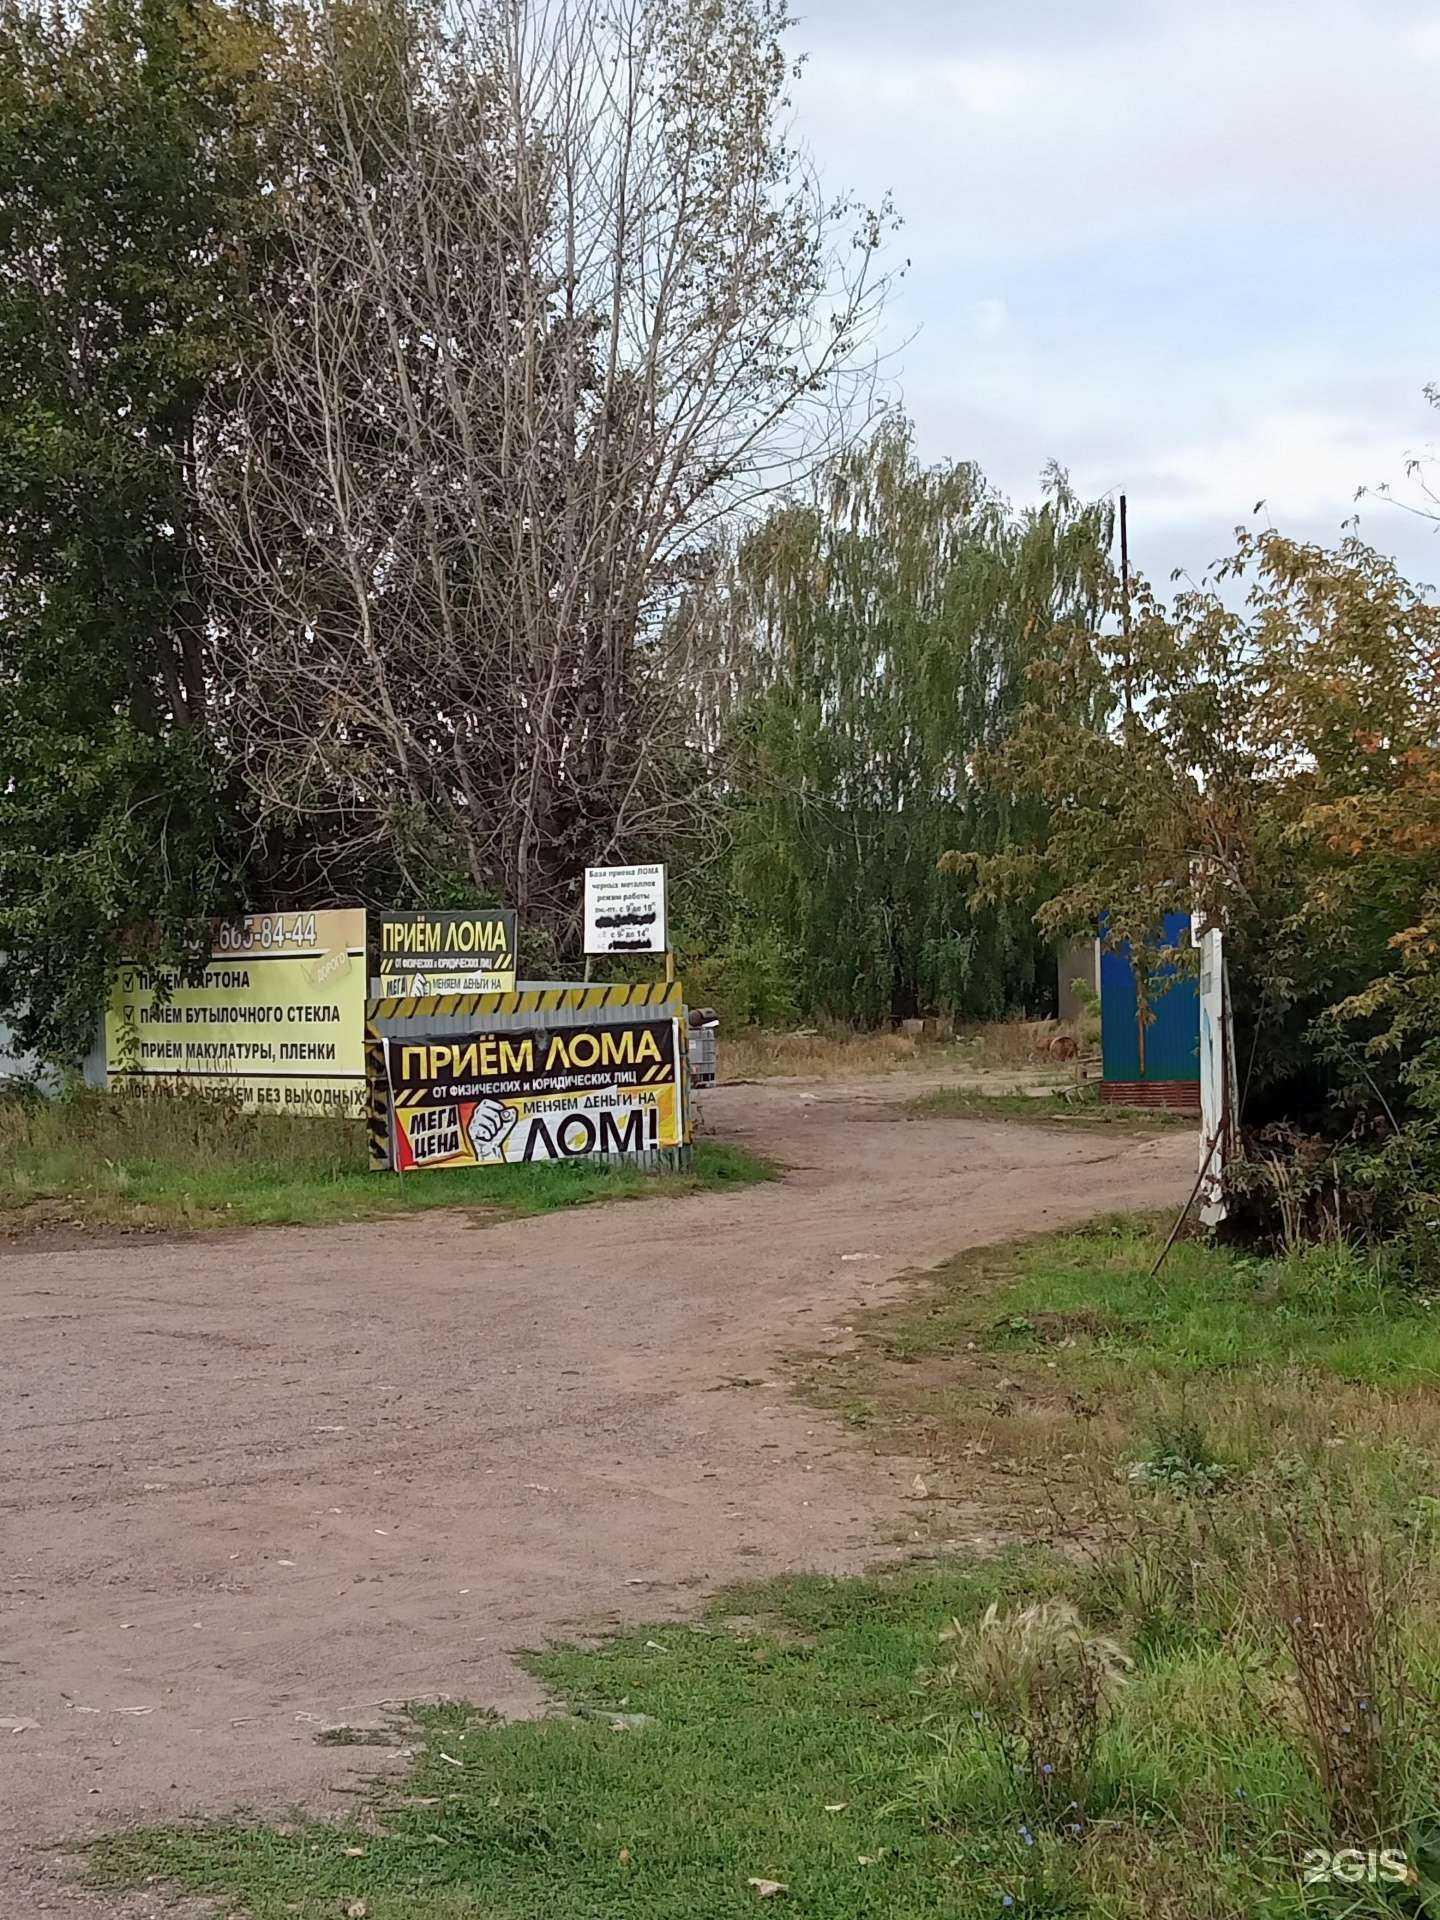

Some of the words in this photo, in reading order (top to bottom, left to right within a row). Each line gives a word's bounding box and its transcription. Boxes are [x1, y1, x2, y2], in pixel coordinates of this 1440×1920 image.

[382, 915, 441, 953] ПРИЁМ
[444, 920, 507, 952] ЛОМА
[432, 978, 461, 990] МЕНЯЕМ
[462, 978, 488, 990] ДЕНЬГИ
[491, 978, 502, 989] НА
[186, 1005, 283, 1024] БУТЫЛОЧНОГО
[287, 1005, 341, 1023] СТЕКЛА
[141, 1041, 183, 1059] ПРИЁМ
[186, 1042, 276, 1063] МАКУЛАТУРЫ,
[280, 1042, 336, 1060] ПЛЕНКИ
[401, 1034, 535, 1081] ПРИЁМ
[545, 1030, 663, 1070] ЛОМА
[257, 1087, 281, 1103] БЕЗ
[432, 1086, 448, 1099] ОТ
[450, 1081, 521, 1097] ФИЗИЧЕСКИХ
[532, 1073, 612, 1091] ЮРИДИЧЕСКИХ
[613, 1070, 637, 1085] ЛИЦ
[523, 1096, 579, 1116] МЕНЯЕМ
[584, 1094, 633, 1110] ДЕНЬГИ
[638, 1091, 656, 1106] НА
[410, 1105, 458, 1136] МЕГА
[522, 1107, 660, 1162] ЛОМ!
[413, 1130, 460, 1161] ЦЕНА
